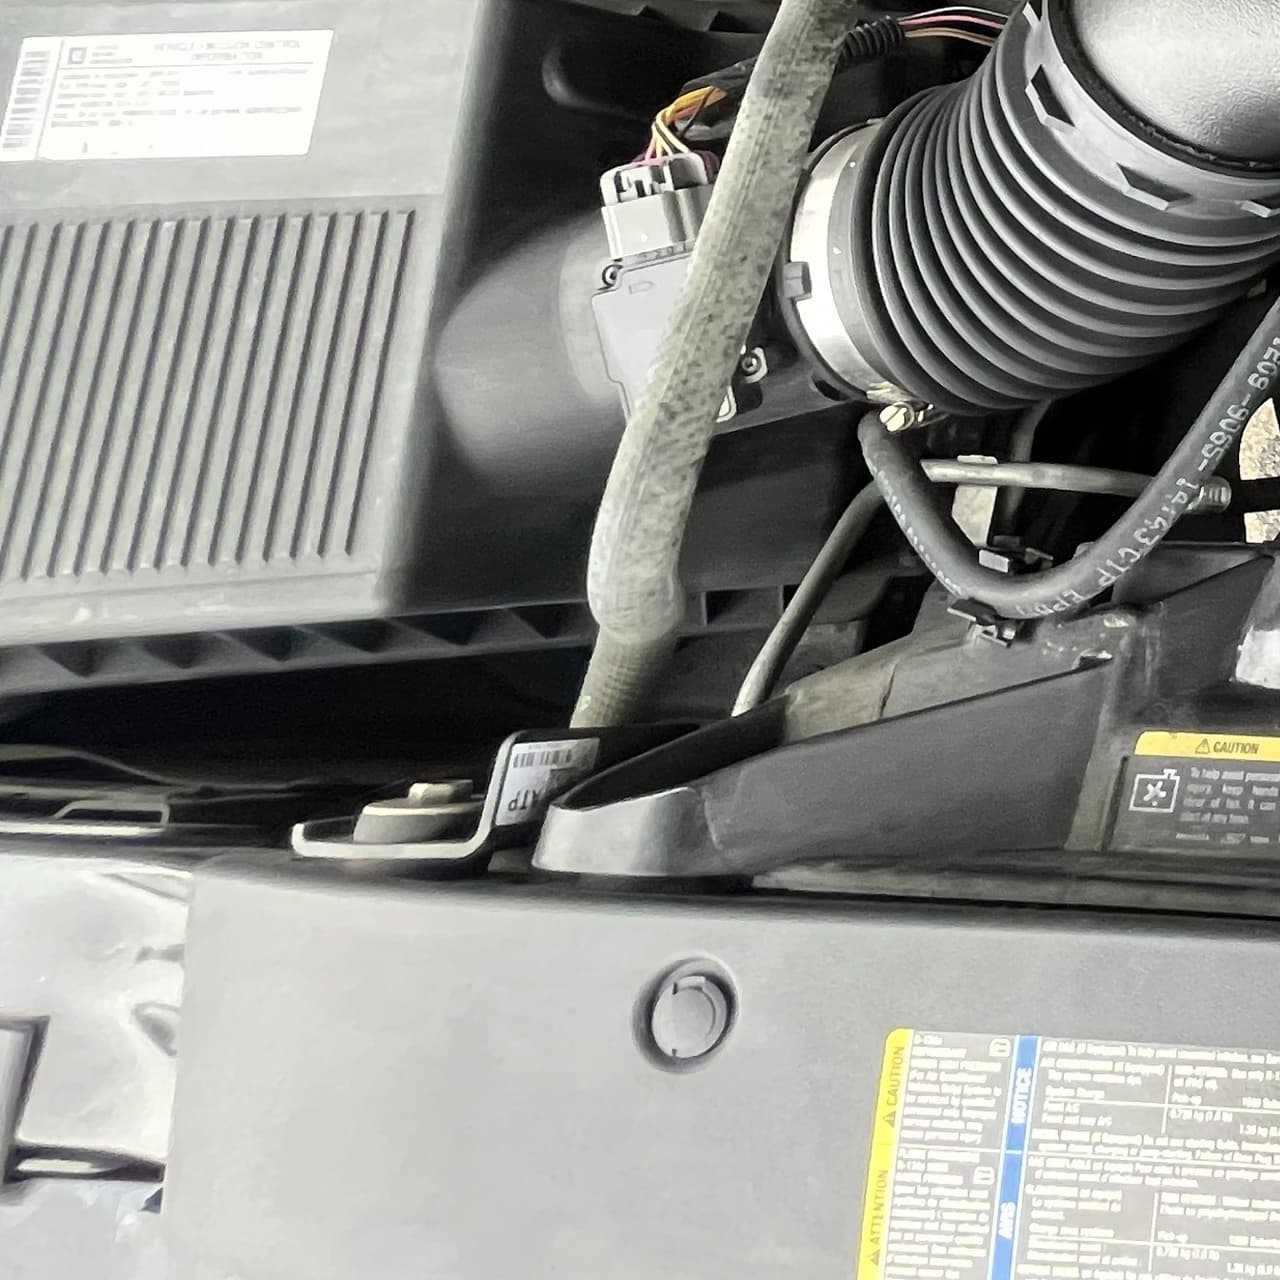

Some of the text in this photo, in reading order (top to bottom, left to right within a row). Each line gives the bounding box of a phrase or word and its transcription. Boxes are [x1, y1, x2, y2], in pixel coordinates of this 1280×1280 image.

[1213, 741, 1259, 754] CAUTION
[883, 1046, 904, 1106] CAUTION
[1010, 1067, 1032, 1124] NOTICE
[870, 1170, 890, 1245] ATTENTION
